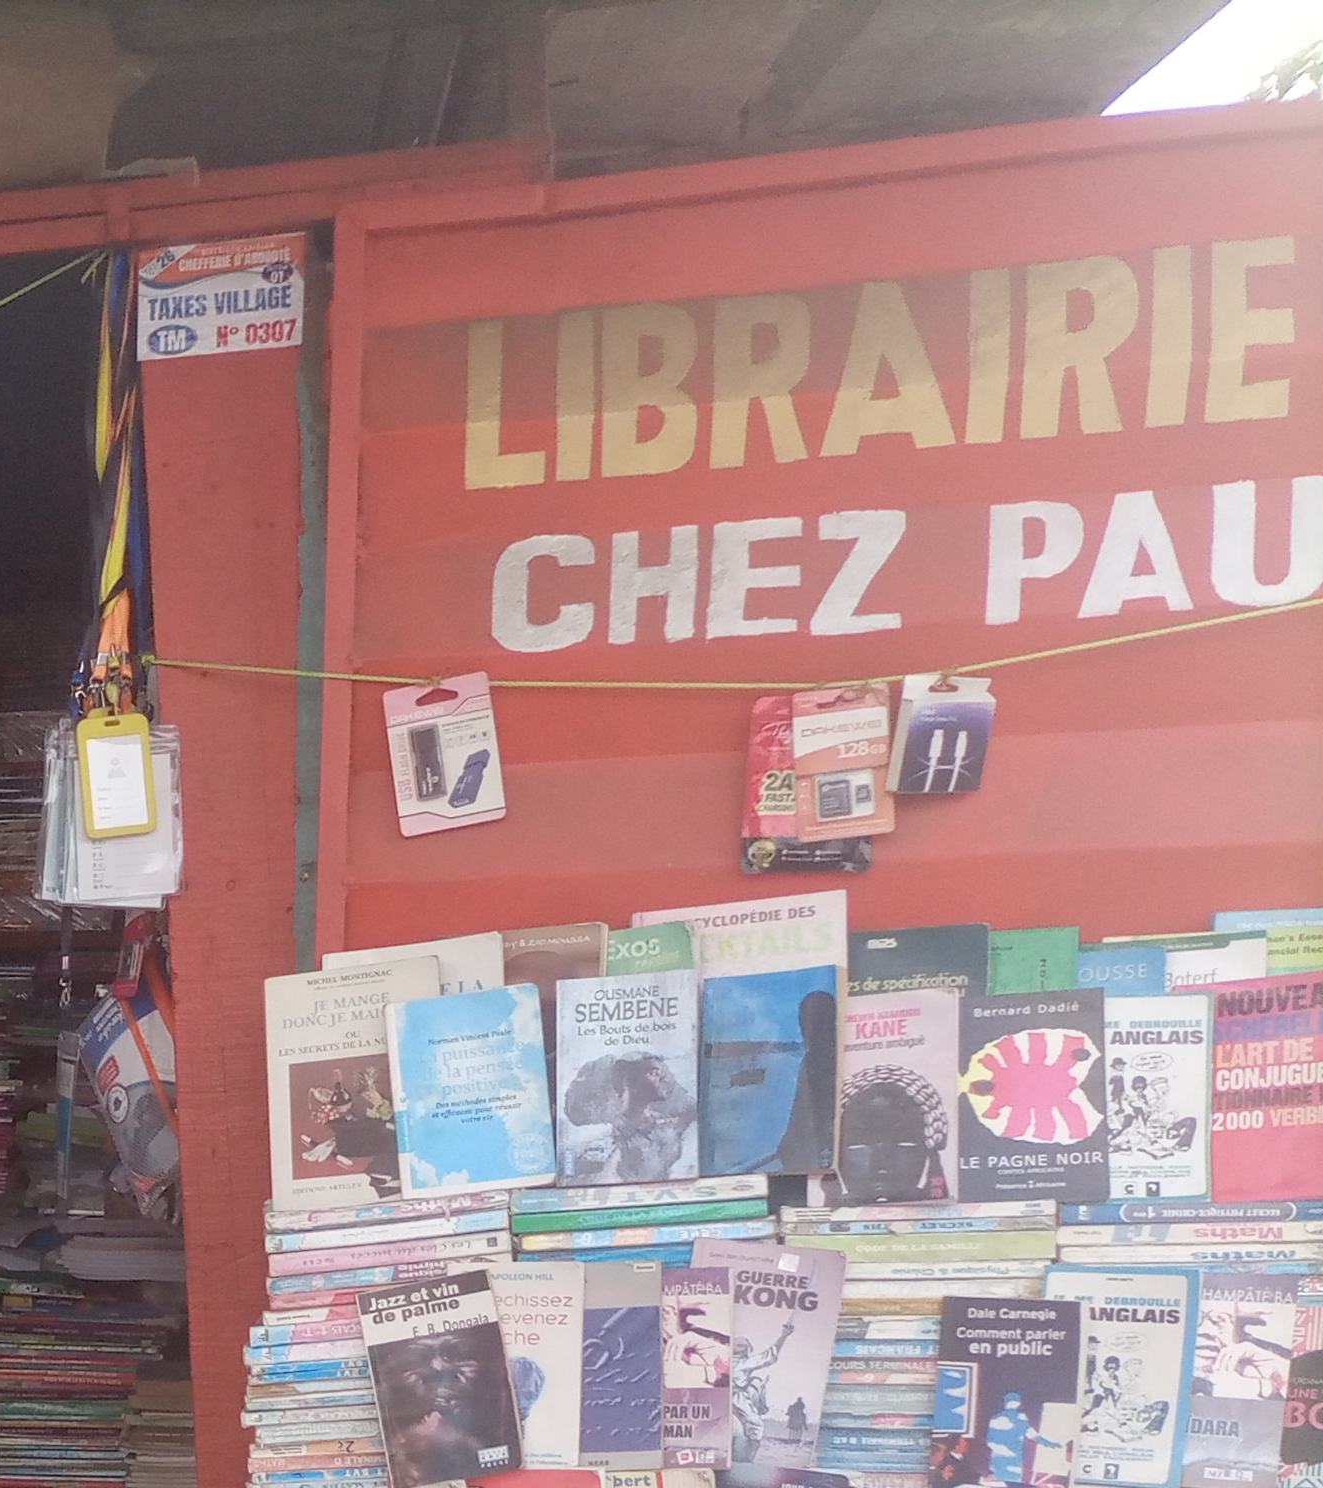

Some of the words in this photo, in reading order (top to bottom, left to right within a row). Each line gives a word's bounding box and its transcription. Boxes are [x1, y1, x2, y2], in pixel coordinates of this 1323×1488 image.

[148, 294, 207, 320] TAXES
[214, 285, 292, 315] VILLAGE
[157, 329, 186, 351] TM
[245, 318, 297, 345] 0307
[464, 234, 1296, 490] LIBRAIRIE
[490, 509, 907, 652] CHEZ
[985, 473, 1323, 626] PAU
[593, 985, 660, 1002] OUSMANE
[574, 997, 679, 1023] SEMBENE
[973, 1004, 1033, 1018] Bernard
[1037, 1000, 1080, 1015] Dadié
[345, 1030, 360, 1040] OU
[577, 1024, 597, 1037] Les
[600, 1024, 634, 1038] Bouts
[636, 1023, 649, 1034] de
[652, 1019, 677, 1034] bois
[855, 1020, 908, 1038] KANE
[1110, 1030, 1204, 1045] ANGLAIS
[603, 1035, 619, 1048] de
[622, 1033, 649, 1046] Dieu
[1216, 1041, 1278, 1068] L'ART
[1281, 1037, 1314, 1062] DE
[959, 1155, 981, 1169] LE
[987, 1153, 1049, 1168] PAGNE
[1056, 1150, 1104, 1166] NOIR
[736, 1270, 809, 1290] GUERRE
[369, 1295, 406, 1313] Jazz
[410, 1288, 428, 1303] et
[432, 1282, 459, 1297] vin
[734, 1283, 819, 1311] KONG
[372, 1310, 396, 1325] de
[401, 1298, 459, 1323] palme
[967, 1307, 994, 1321] Dale
[995, 1307, 1057, 1323] Carnegie
[956, 1326, 1021, 1341] Comment
[1024, 1327, 1066, 1343] parler
[969, 1342, 995, 1355] en
[998, 1340, 1053, 1357] public
